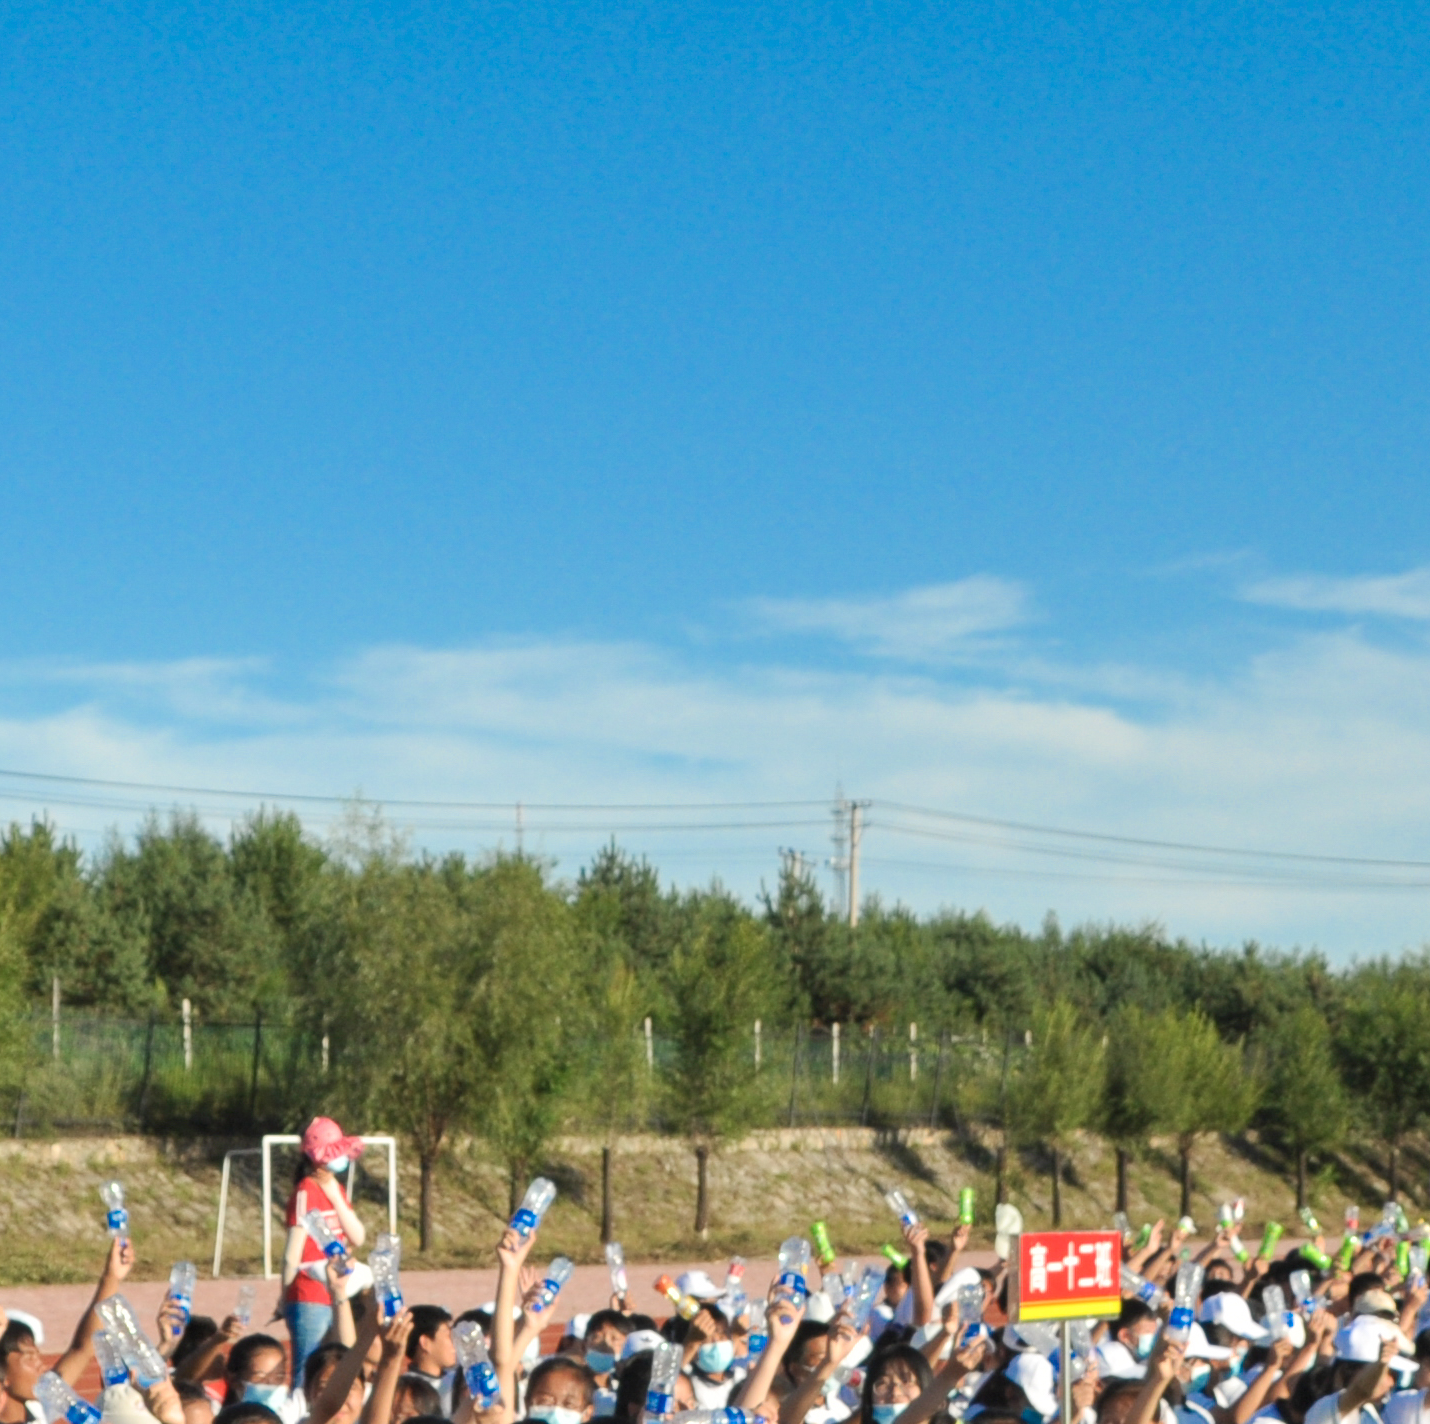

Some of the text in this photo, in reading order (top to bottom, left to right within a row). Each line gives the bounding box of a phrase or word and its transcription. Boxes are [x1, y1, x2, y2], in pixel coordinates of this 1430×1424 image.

[1029, 1241, 1113, 1293] 高一十二班
